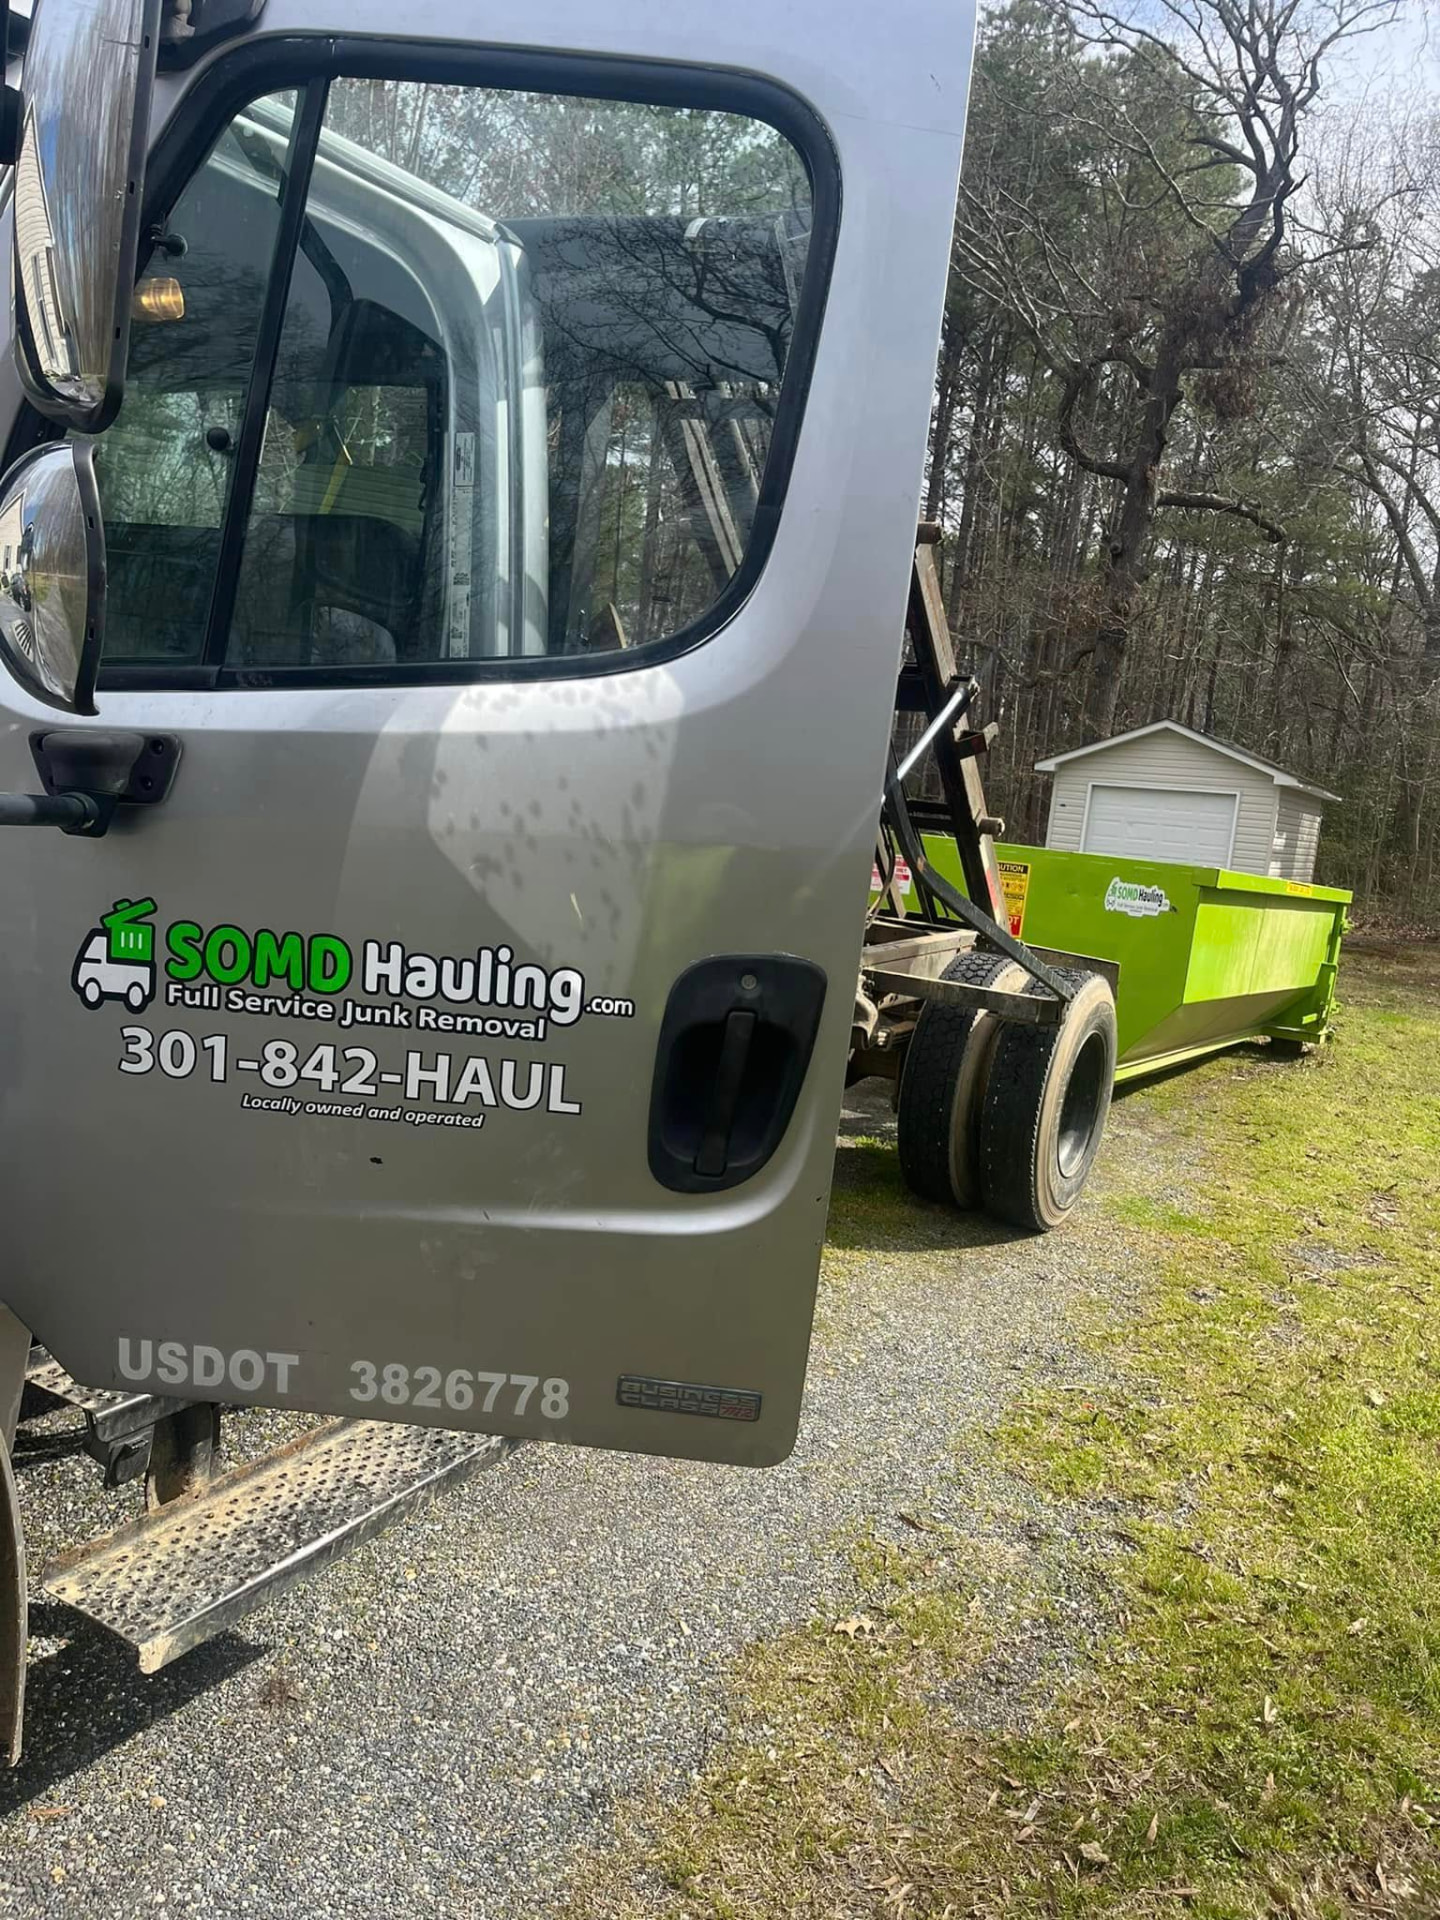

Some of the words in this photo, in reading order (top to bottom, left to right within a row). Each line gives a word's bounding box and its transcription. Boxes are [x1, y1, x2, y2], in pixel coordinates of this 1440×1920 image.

[999, 864, 1025, 874] UTION
[165, 921, 352, 994] SOMD
[167, 984, 220, 1009] Full
[226, 989, 335, 1019] Service
[340, 1001, 412, 1028] Junk
[418, 1008, 547, 1040] Removal
[118, 1025, 582, 1115] 301-842-HAUL
[241, 1094, 301, 1114] Locally
[305, 1102, 365, 1118] owned
[367, 1107, 402, 1121] and
[405, 1110, 485, 1128] operated
[117, 1337, 300, 1394] USDOT
[349, 1360, 571, 1419] 3826778
[620, 1381, 756, 1407] BUSINESS
[620, 1393, 719, 1415] CLASS
